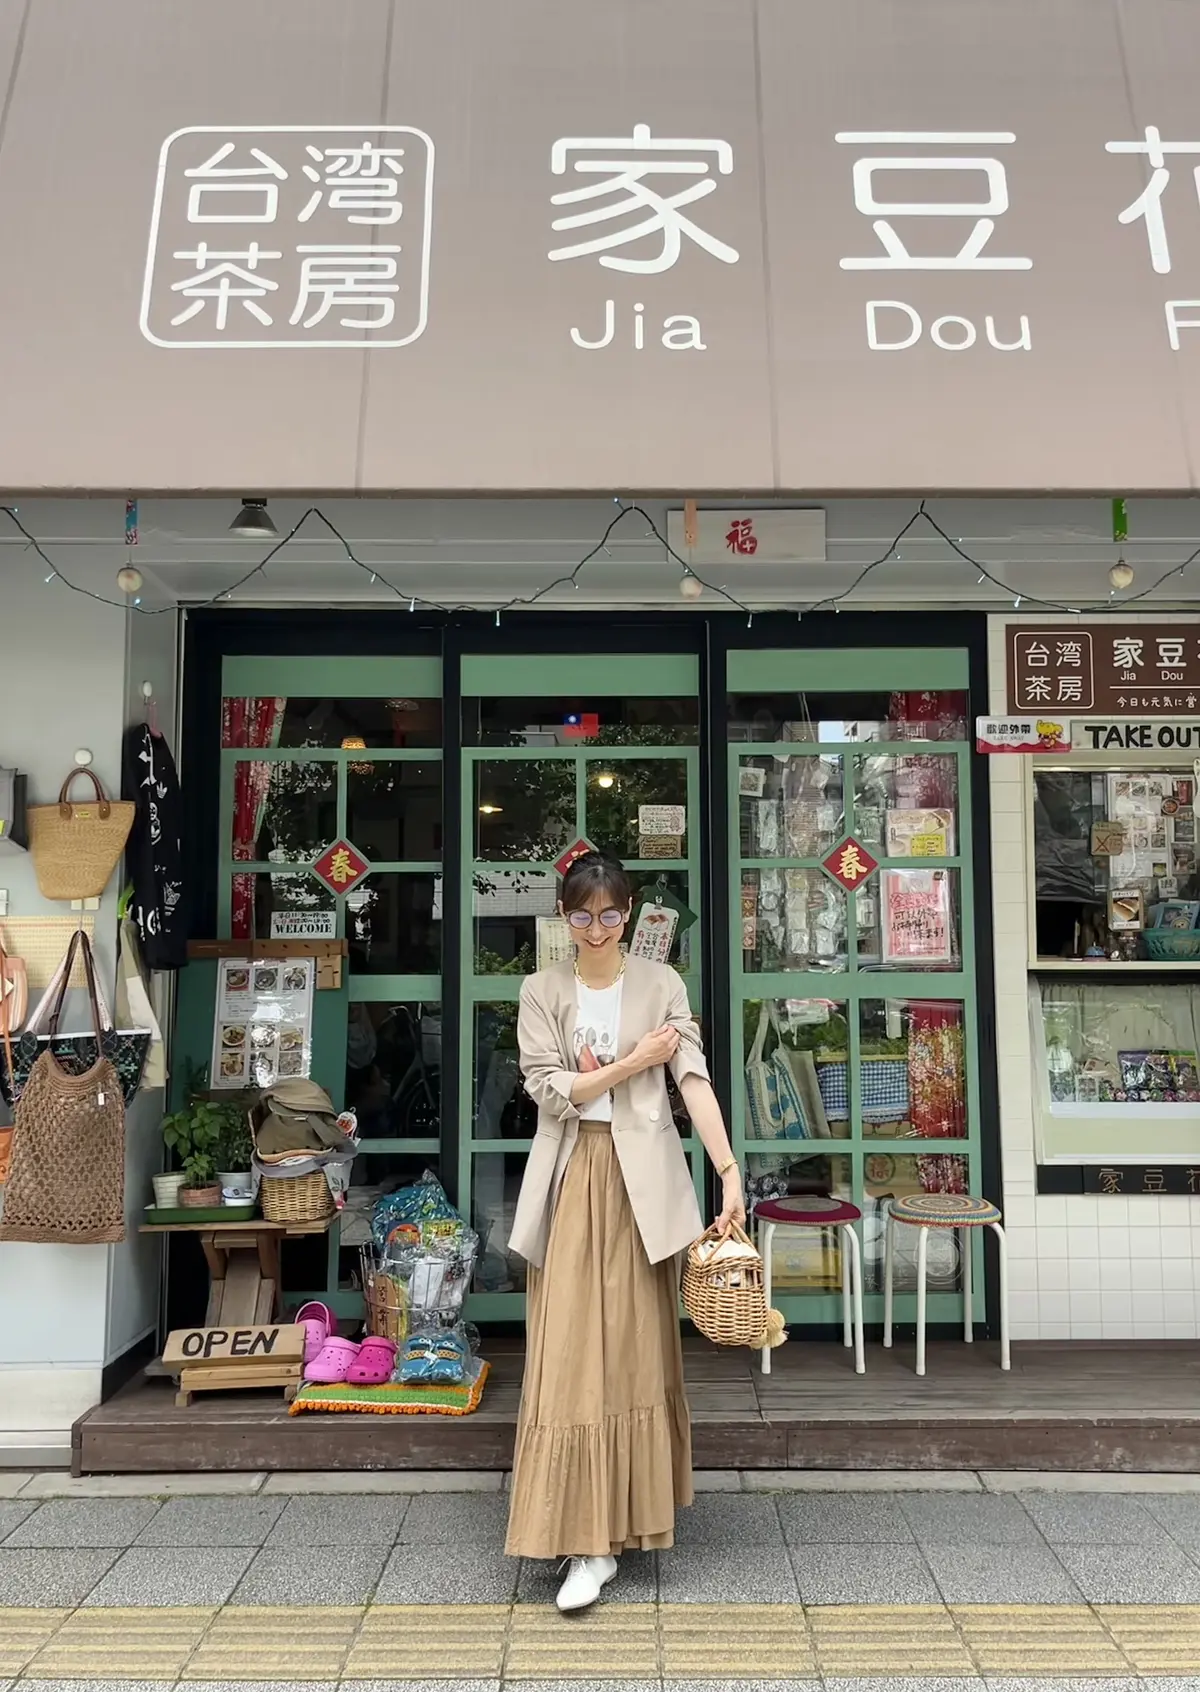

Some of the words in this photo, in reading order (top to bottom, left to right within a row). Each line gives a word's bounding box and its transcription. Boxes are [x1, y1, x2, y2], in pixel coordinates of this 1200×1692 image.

[184, 141, 405, 226] 台湾
[170, 242, 402, 330] 茶房
[570, 300, 708, 351] Jia
[865, 300, 1033, 352] Dou
[725, 518, 758, 555] 福
[1025, 641, 1082, 667] 台湾
[1112, 637, 1200, 668] 家豆
[1025, 675, 1083, 701] 茶房
[1120, 670, 1137, 681] Jia
[1161, 670, 1184, 681] Dou
[1085, 725, 1154, 749] TAKE
[327, 848, 358, 883] 春
[836, 844, 868, 880] 春
[275, 924, 332, 934] WELCOME
[181, 1329, 280, 1359] OPEN
